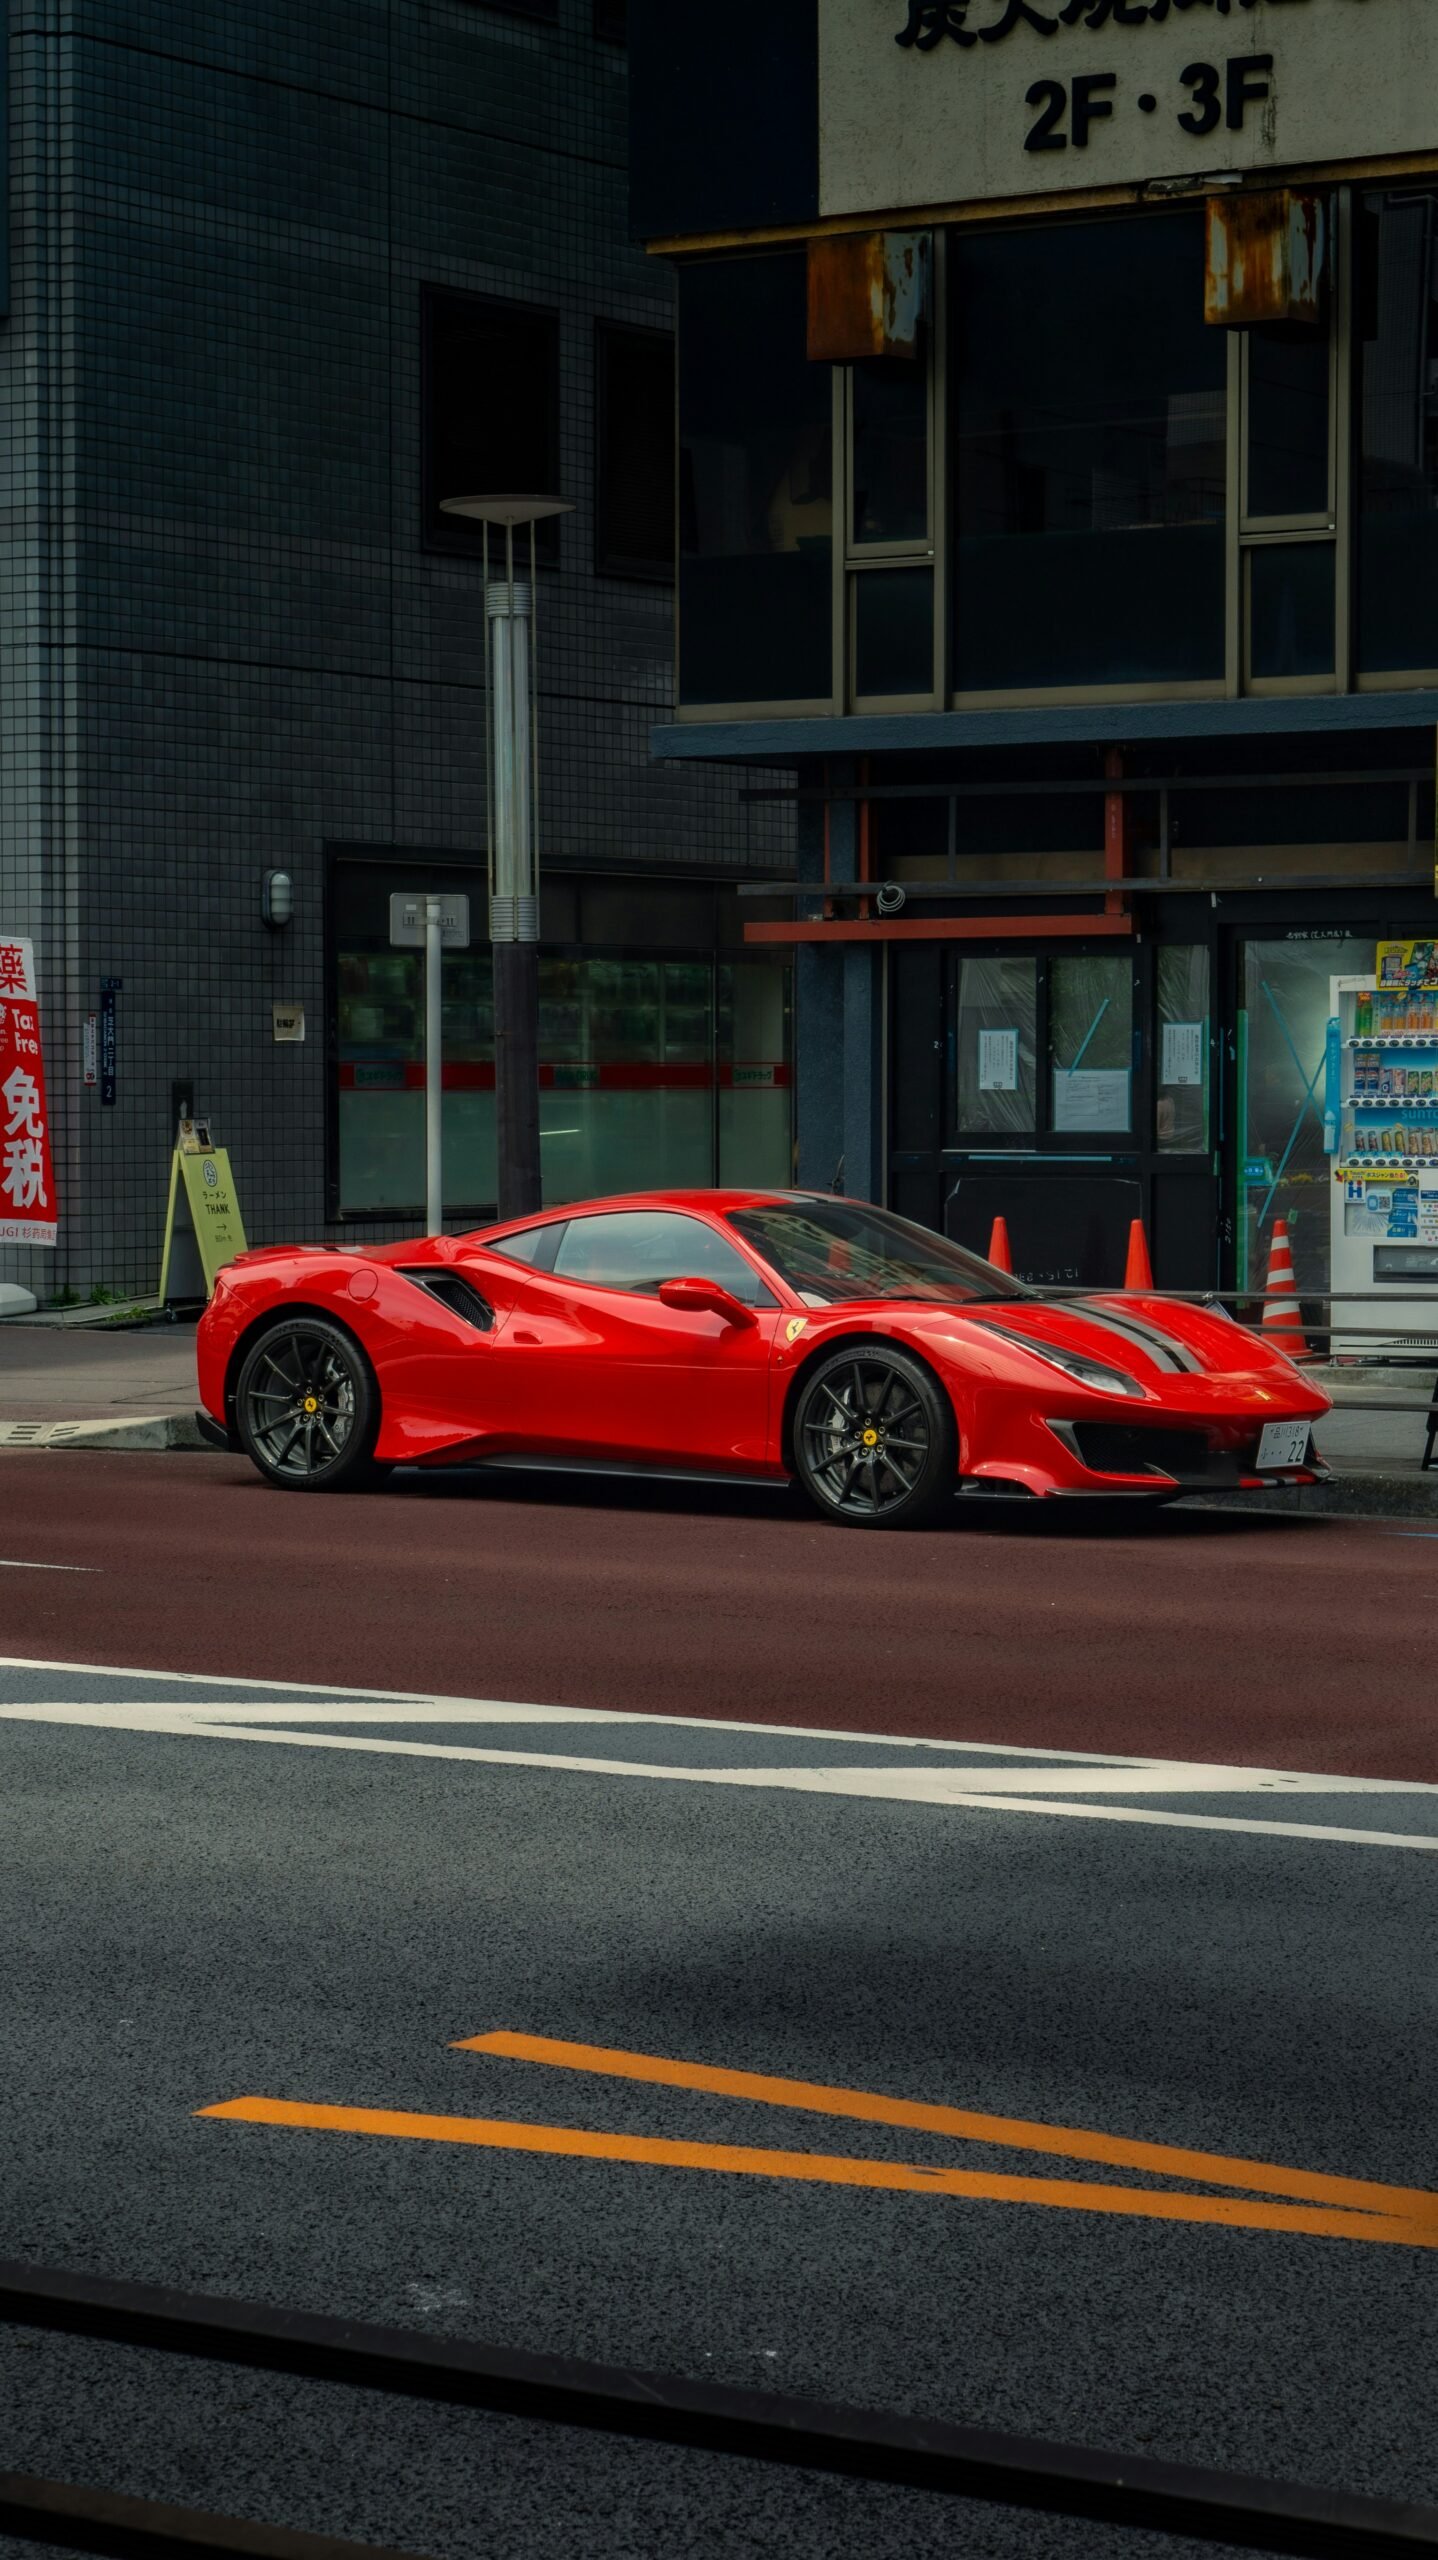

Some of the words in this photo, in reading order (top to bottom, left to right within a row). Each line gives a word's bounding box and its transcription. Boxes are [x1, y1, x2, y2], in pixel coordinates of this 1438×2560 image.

[1, 1065, 48, 1208] 免税
[202, 1191, 227, 1200] ラーメン
[205, 1204, 231, 1215] THANK
[1287, 1440, 1305, 1463] 22
